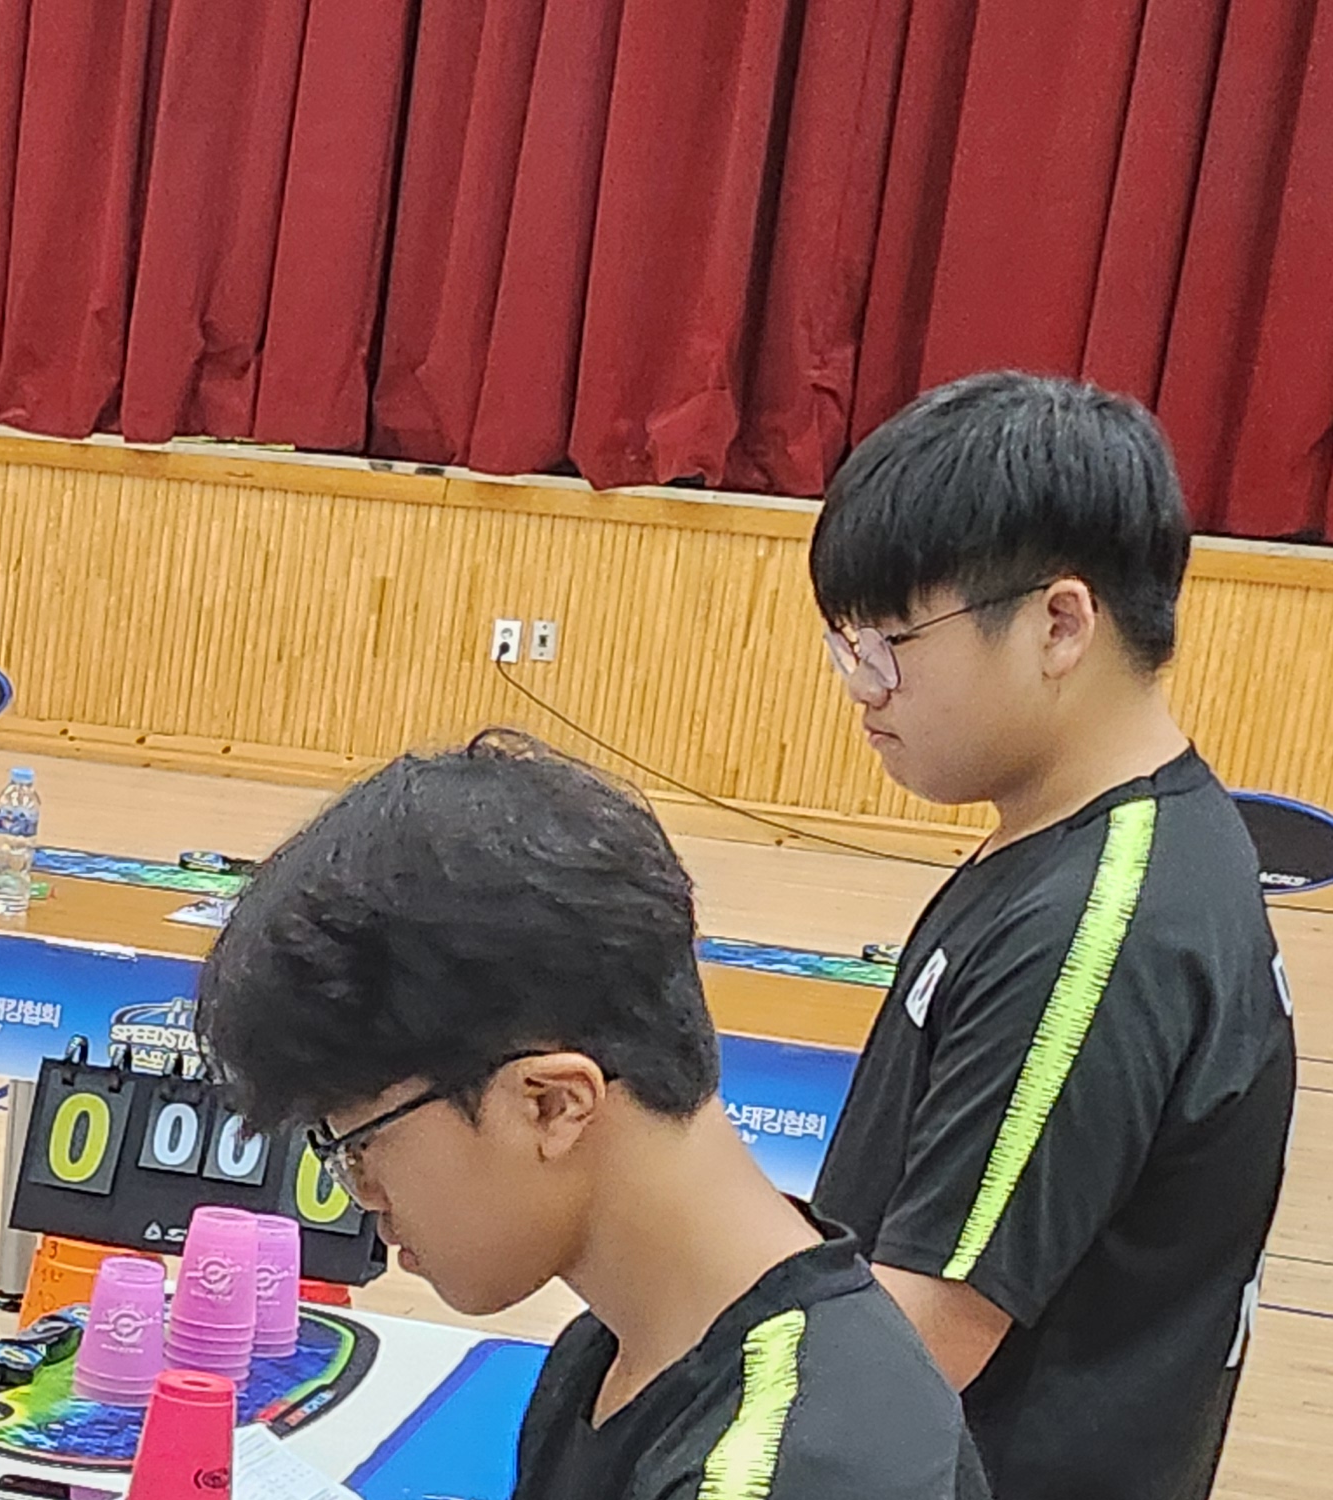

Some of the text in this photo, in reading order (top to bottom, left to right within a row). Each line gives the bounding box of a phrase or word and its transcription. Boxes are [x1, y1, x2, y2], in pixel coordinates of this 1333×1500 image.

[110, 1023, 199, 1051] SPEEDSTA
[48, 1092, 111, 1182] 0
[724, 1102, 827, 1140] 스태킹협회
